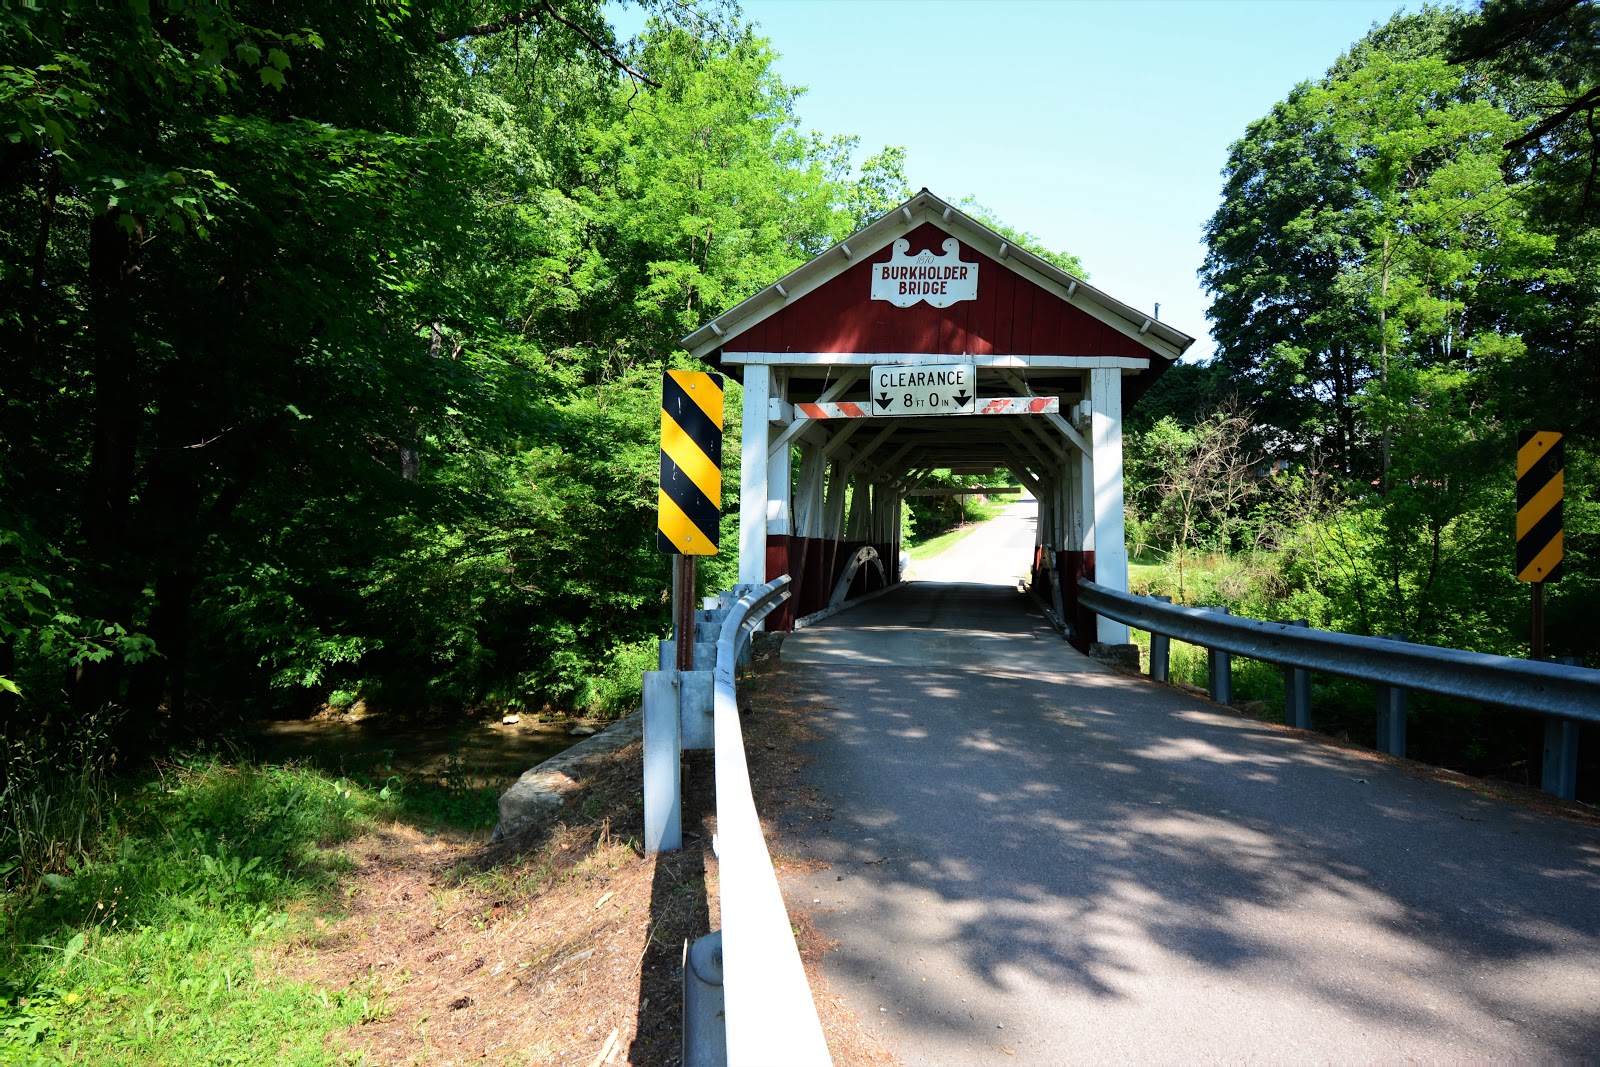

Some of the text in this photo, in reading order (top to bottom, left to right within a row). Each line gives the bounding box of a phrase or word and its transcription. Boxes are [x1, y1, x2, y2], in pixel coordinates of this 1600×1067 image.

[881, 266, 968, 280] BURKHOLDER
[898, 281, 948, 295] BRIDGE
[880, 371, 964, 388] CLEARANCE
[903, 392, 949, 408] 8 FT 0 IN
